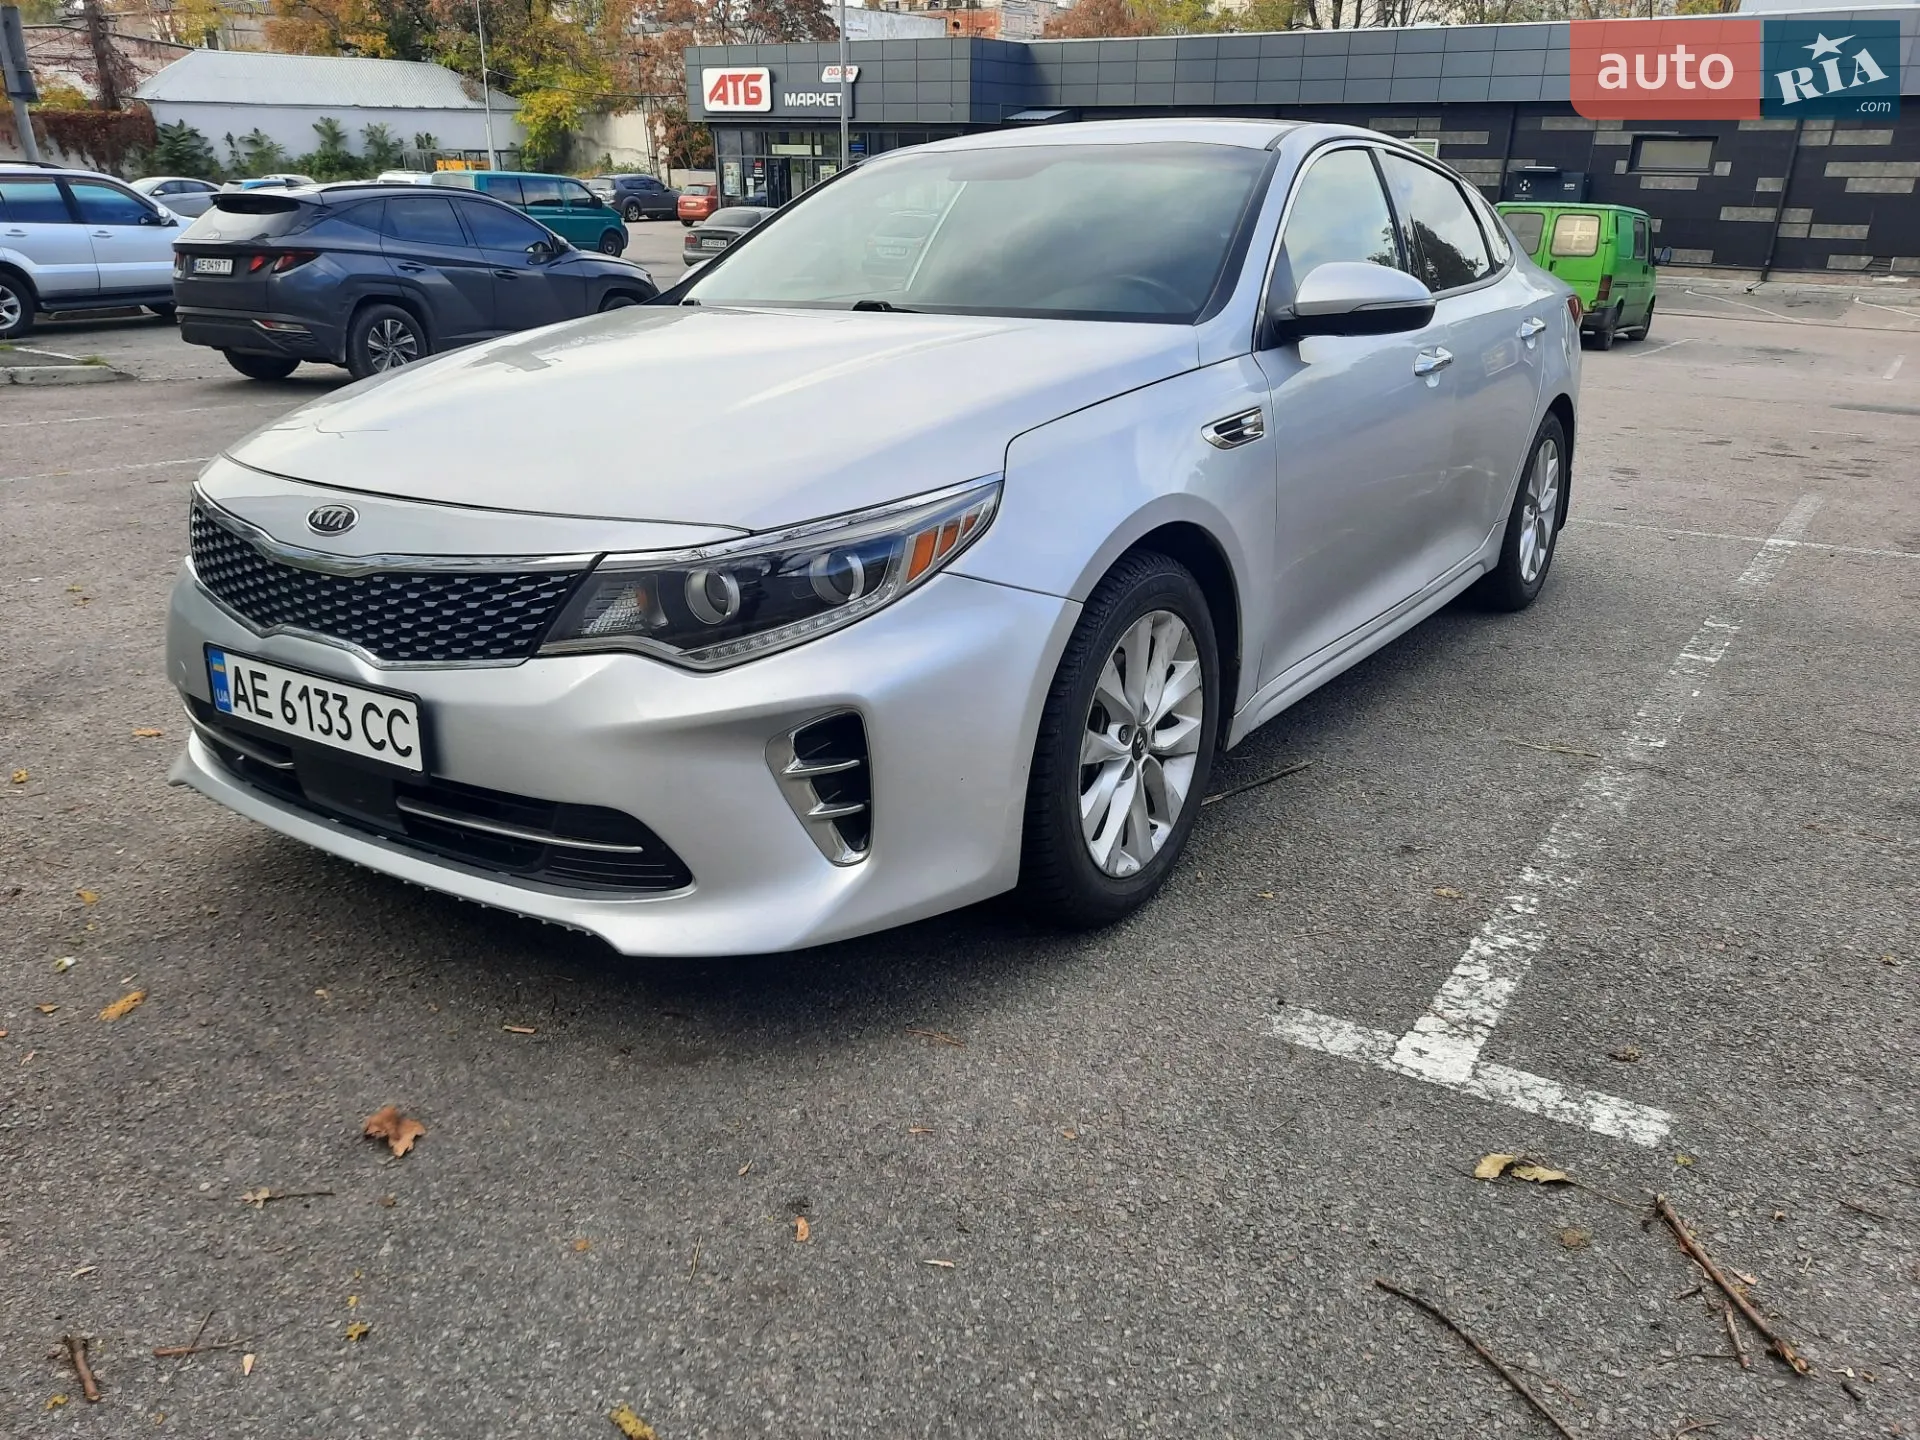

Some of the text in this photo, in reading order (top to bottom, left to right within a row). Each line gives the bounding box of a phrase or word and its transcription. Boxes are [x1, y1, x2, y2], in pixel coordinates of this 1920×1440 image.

[827, 67, 854, 76] 004
[709, 74, 764, 106] АТБ
[784, 92, 842, 107] МАРКЕТ
[312, 508, 348, 529] KIA
[216, 688, 230, 704] UA
[233, 665, 413, 758] AE 6133 CC
